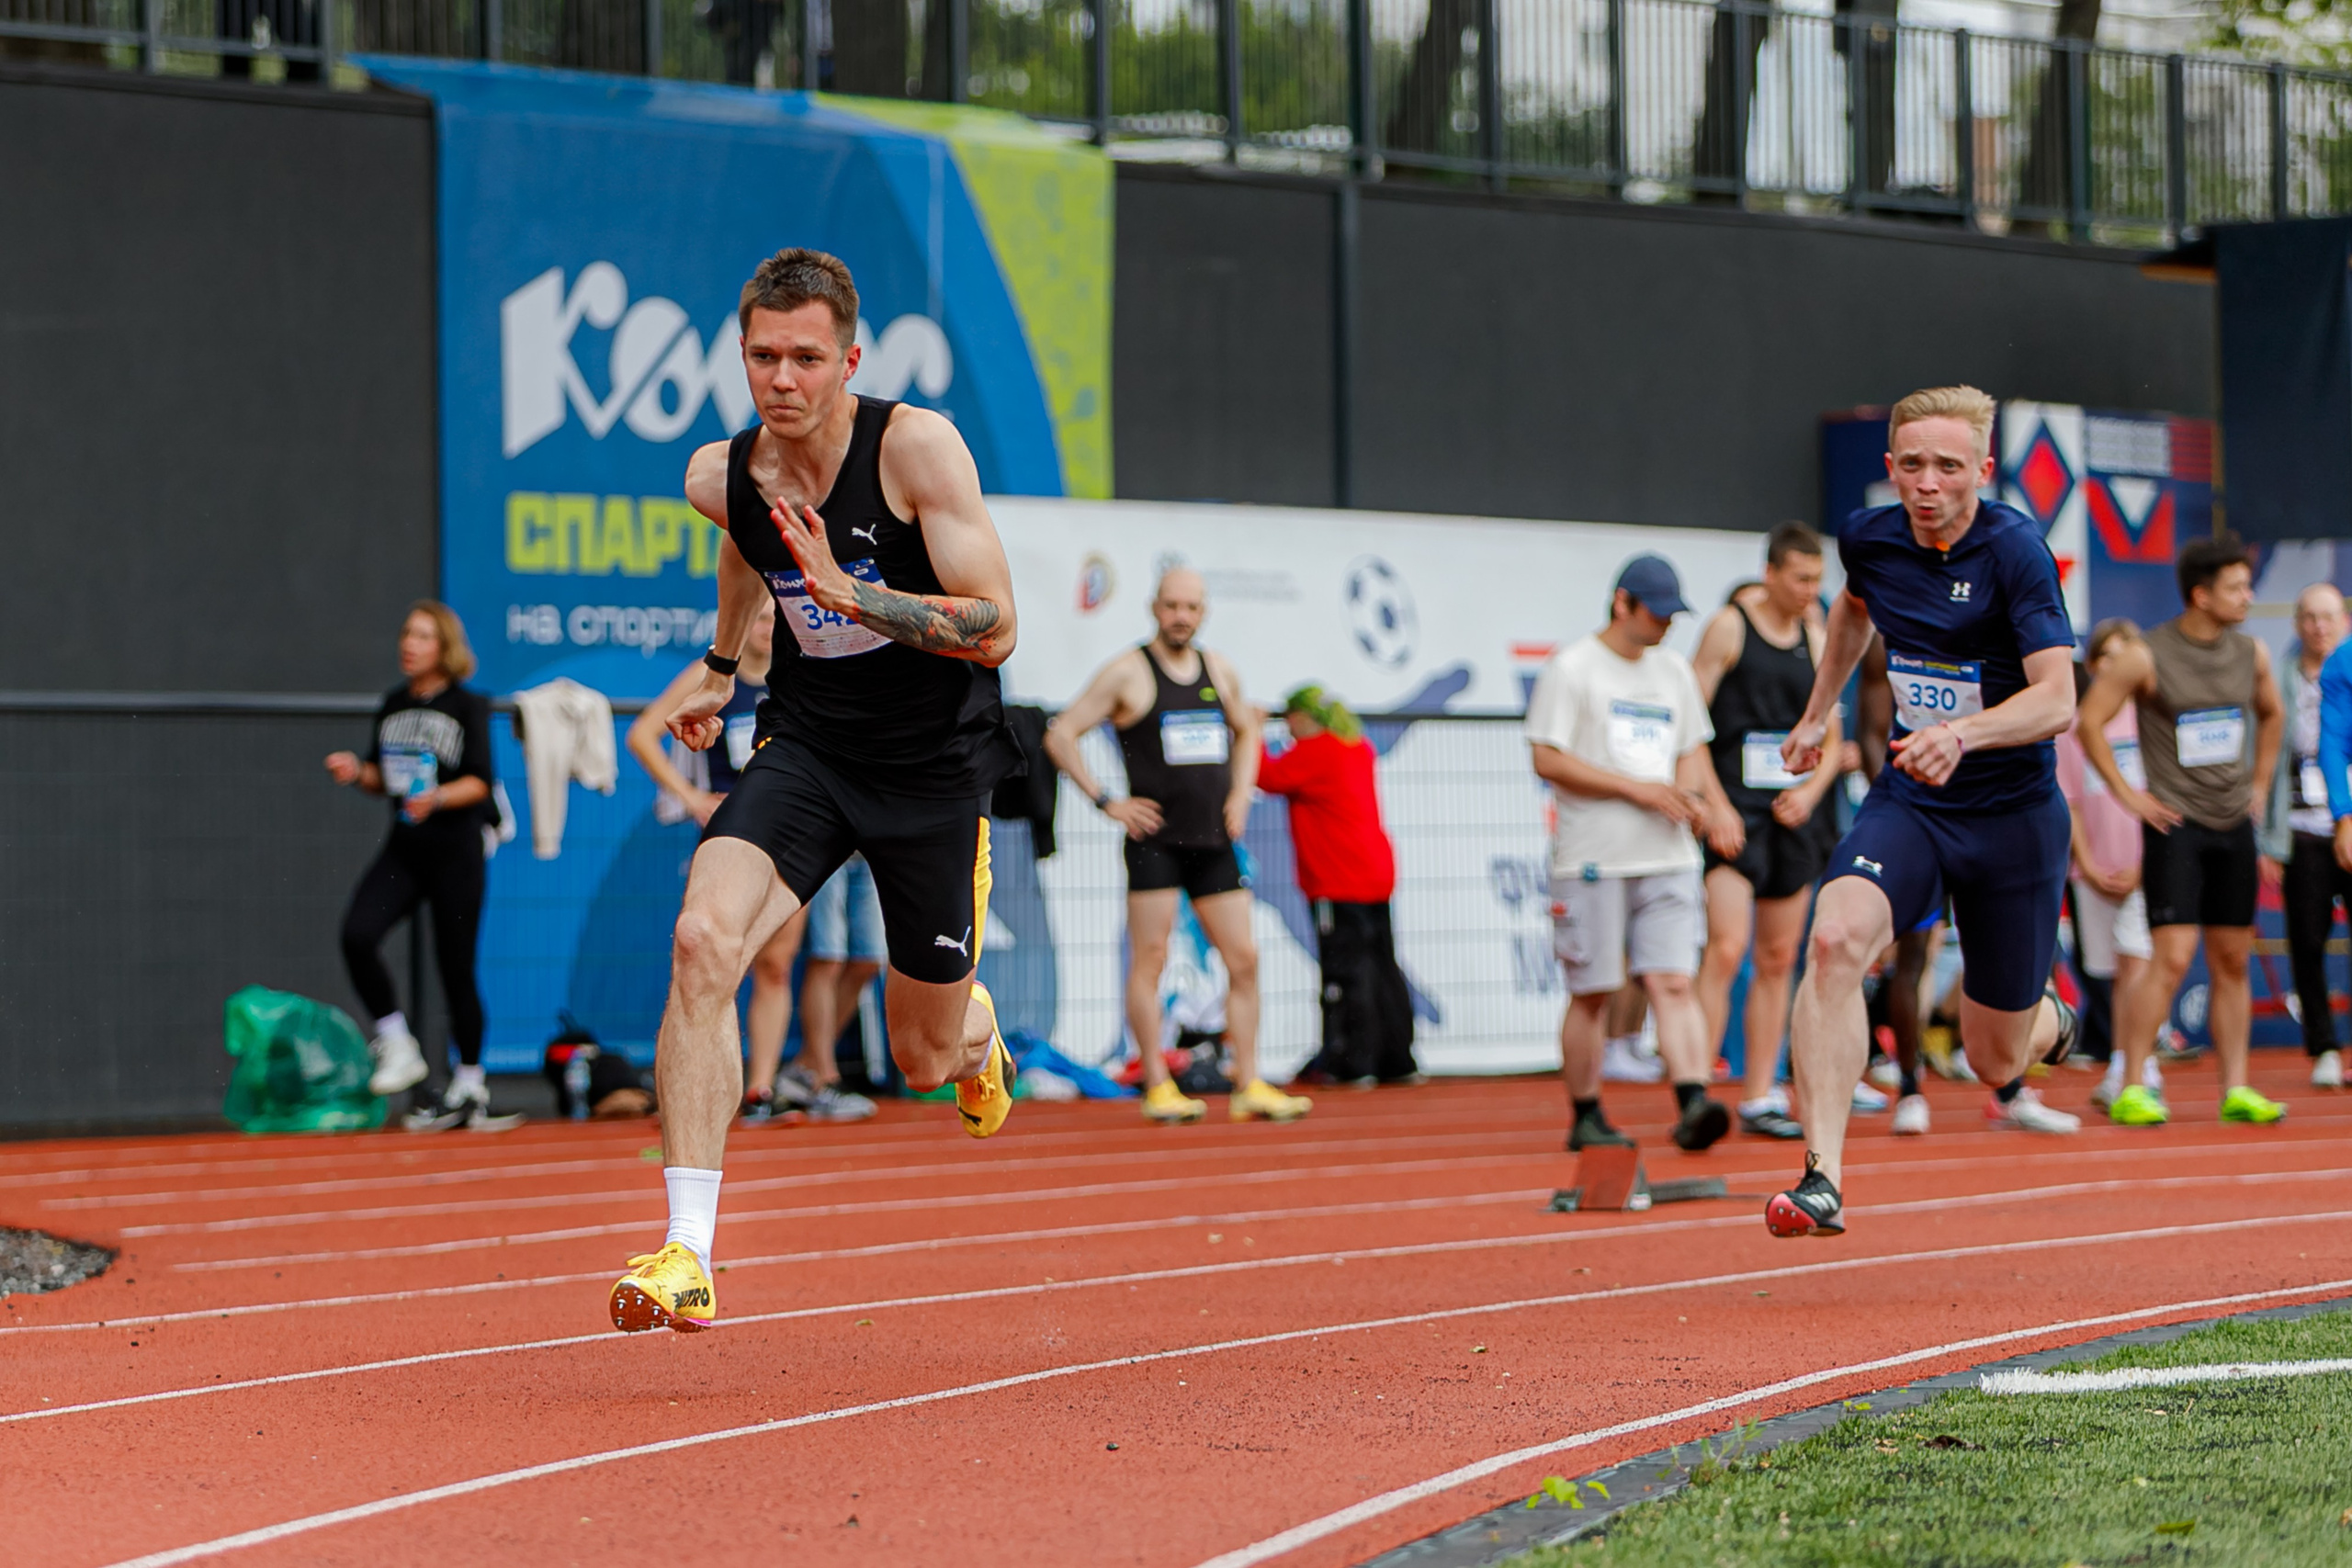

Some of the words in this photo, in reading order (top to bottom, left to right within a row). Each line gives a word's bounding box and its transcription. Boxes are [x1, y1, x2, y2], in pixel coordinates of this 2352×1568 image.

[500, 260, 954, 459] Комс
[505, 491, 723, 579] СПАРТ
[506, 604, 563, 646] на
[1908, 682, 1957, 711] 330
